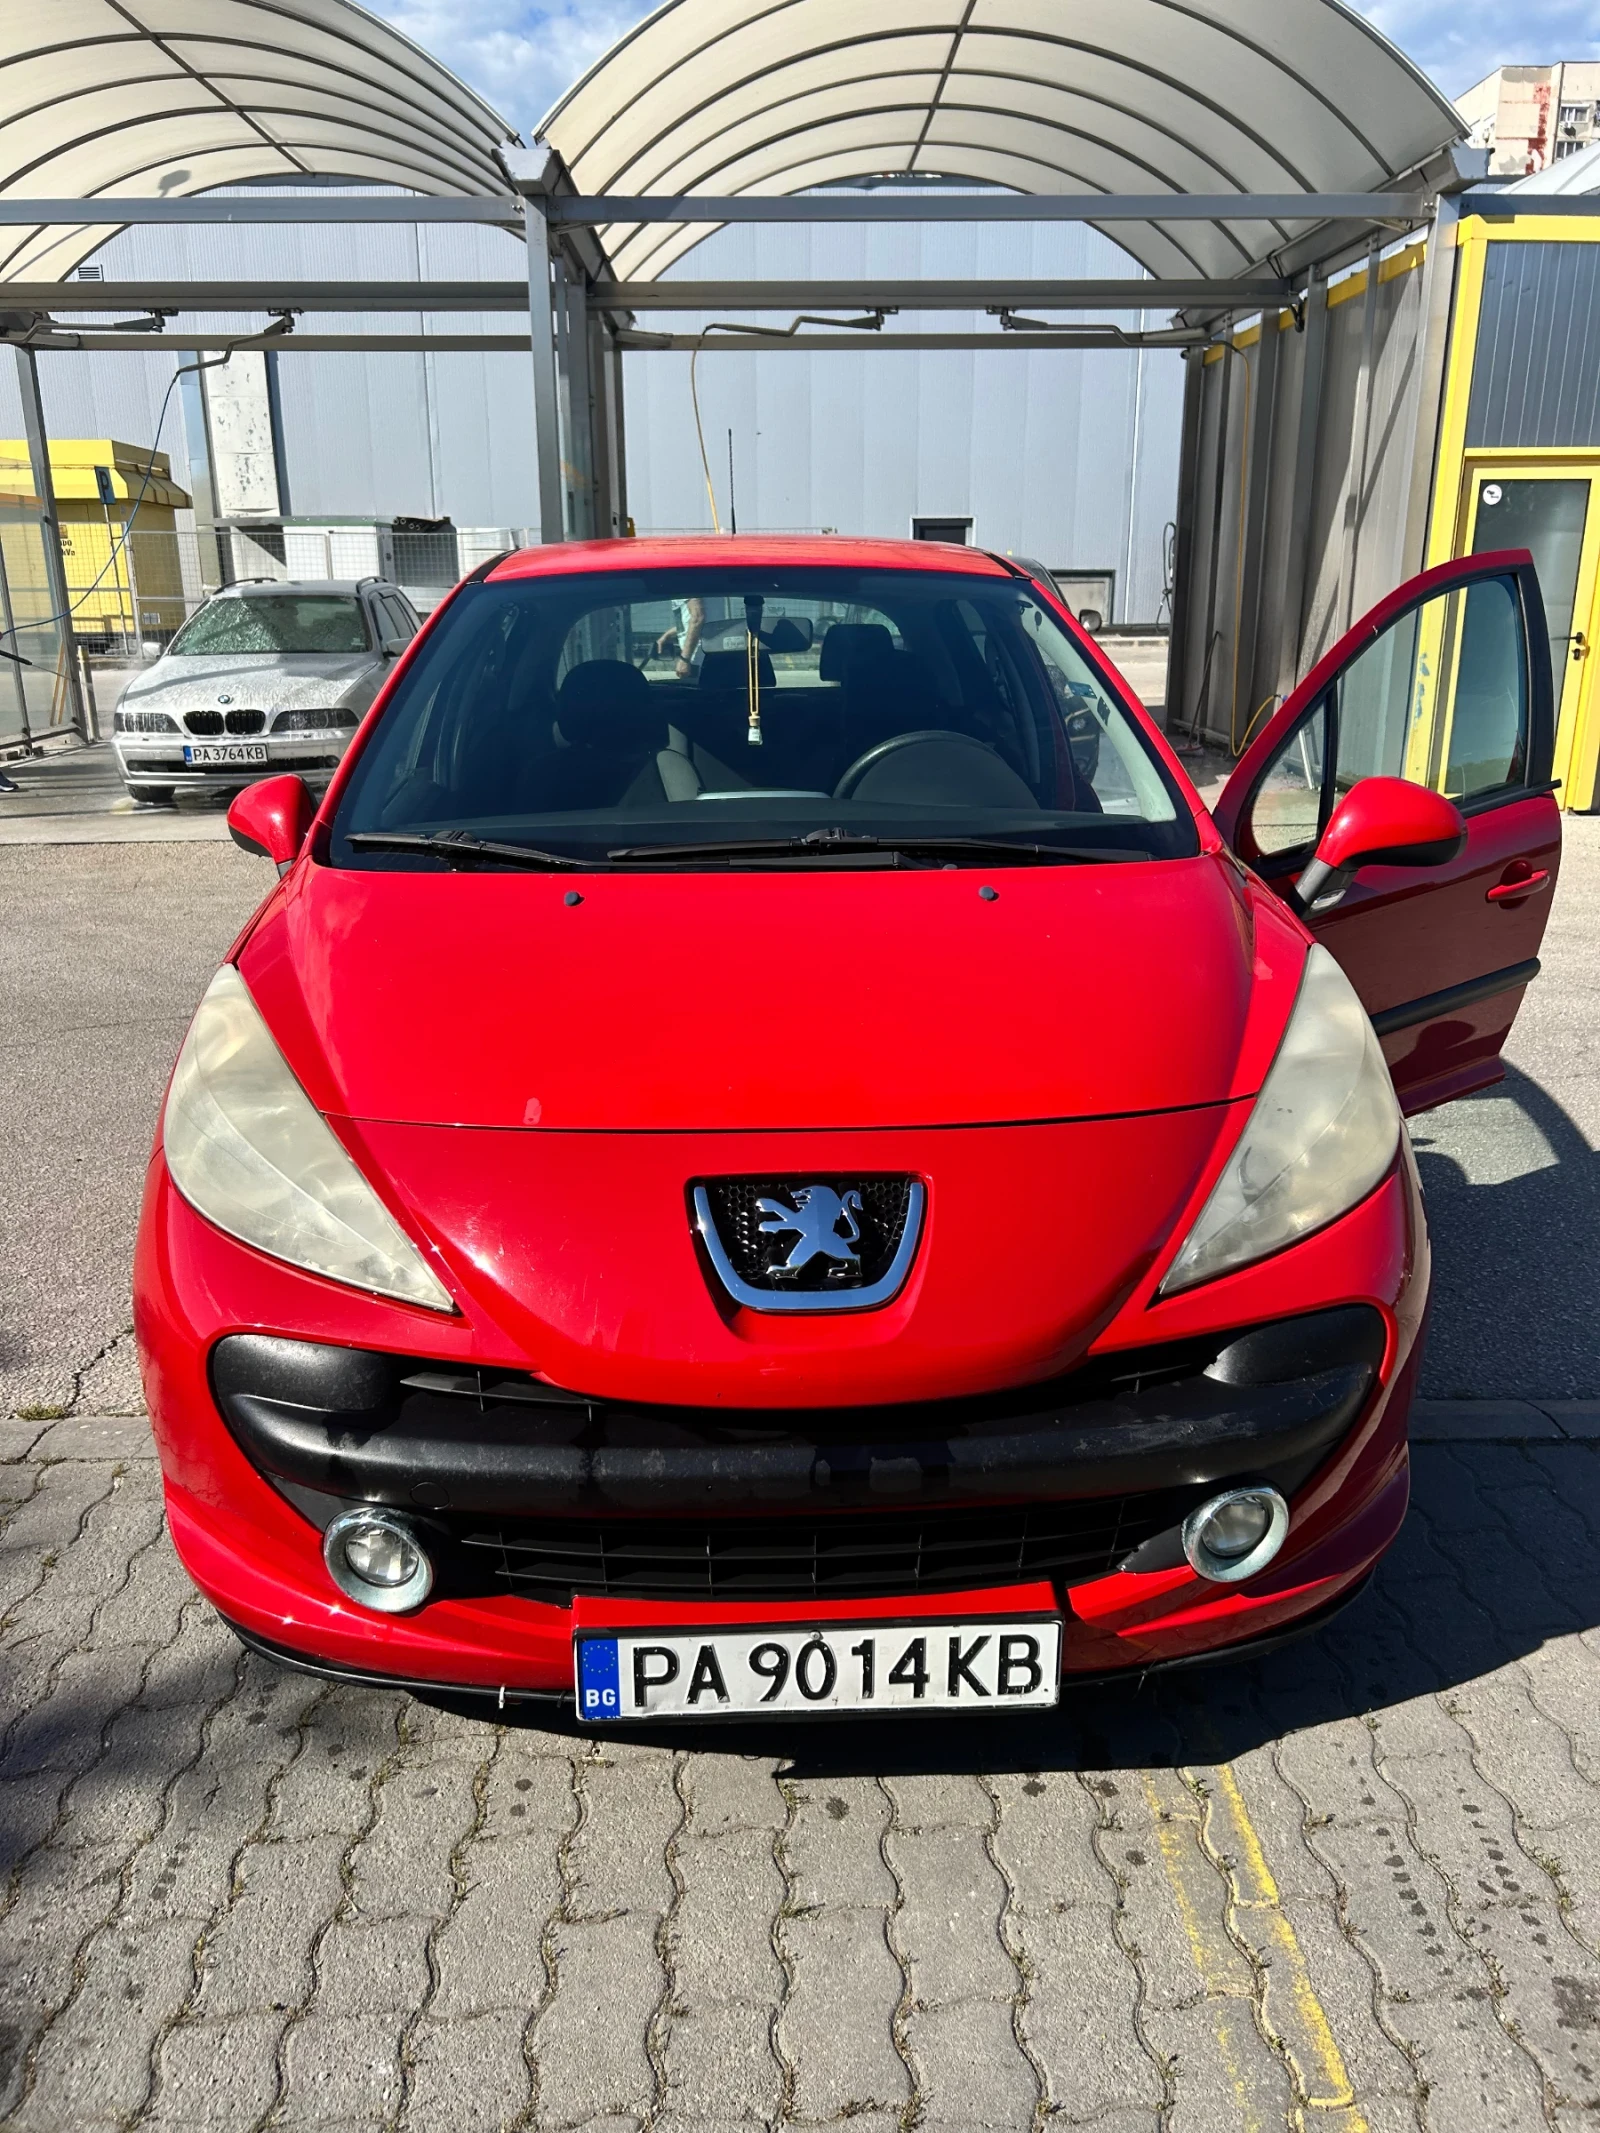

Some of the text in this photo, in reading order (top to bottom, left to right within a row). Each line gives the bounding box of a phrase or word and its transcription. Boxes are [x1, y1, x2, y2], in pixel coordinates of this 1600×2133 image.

[193, 749, 211, 760] PA
[213, 748, 244, 760] 3764
[246, 747, 264, 760] KB
[633, 1635, 1043, 1707] PA 9014 KB
[585, 1688, 616, 1708] BG
